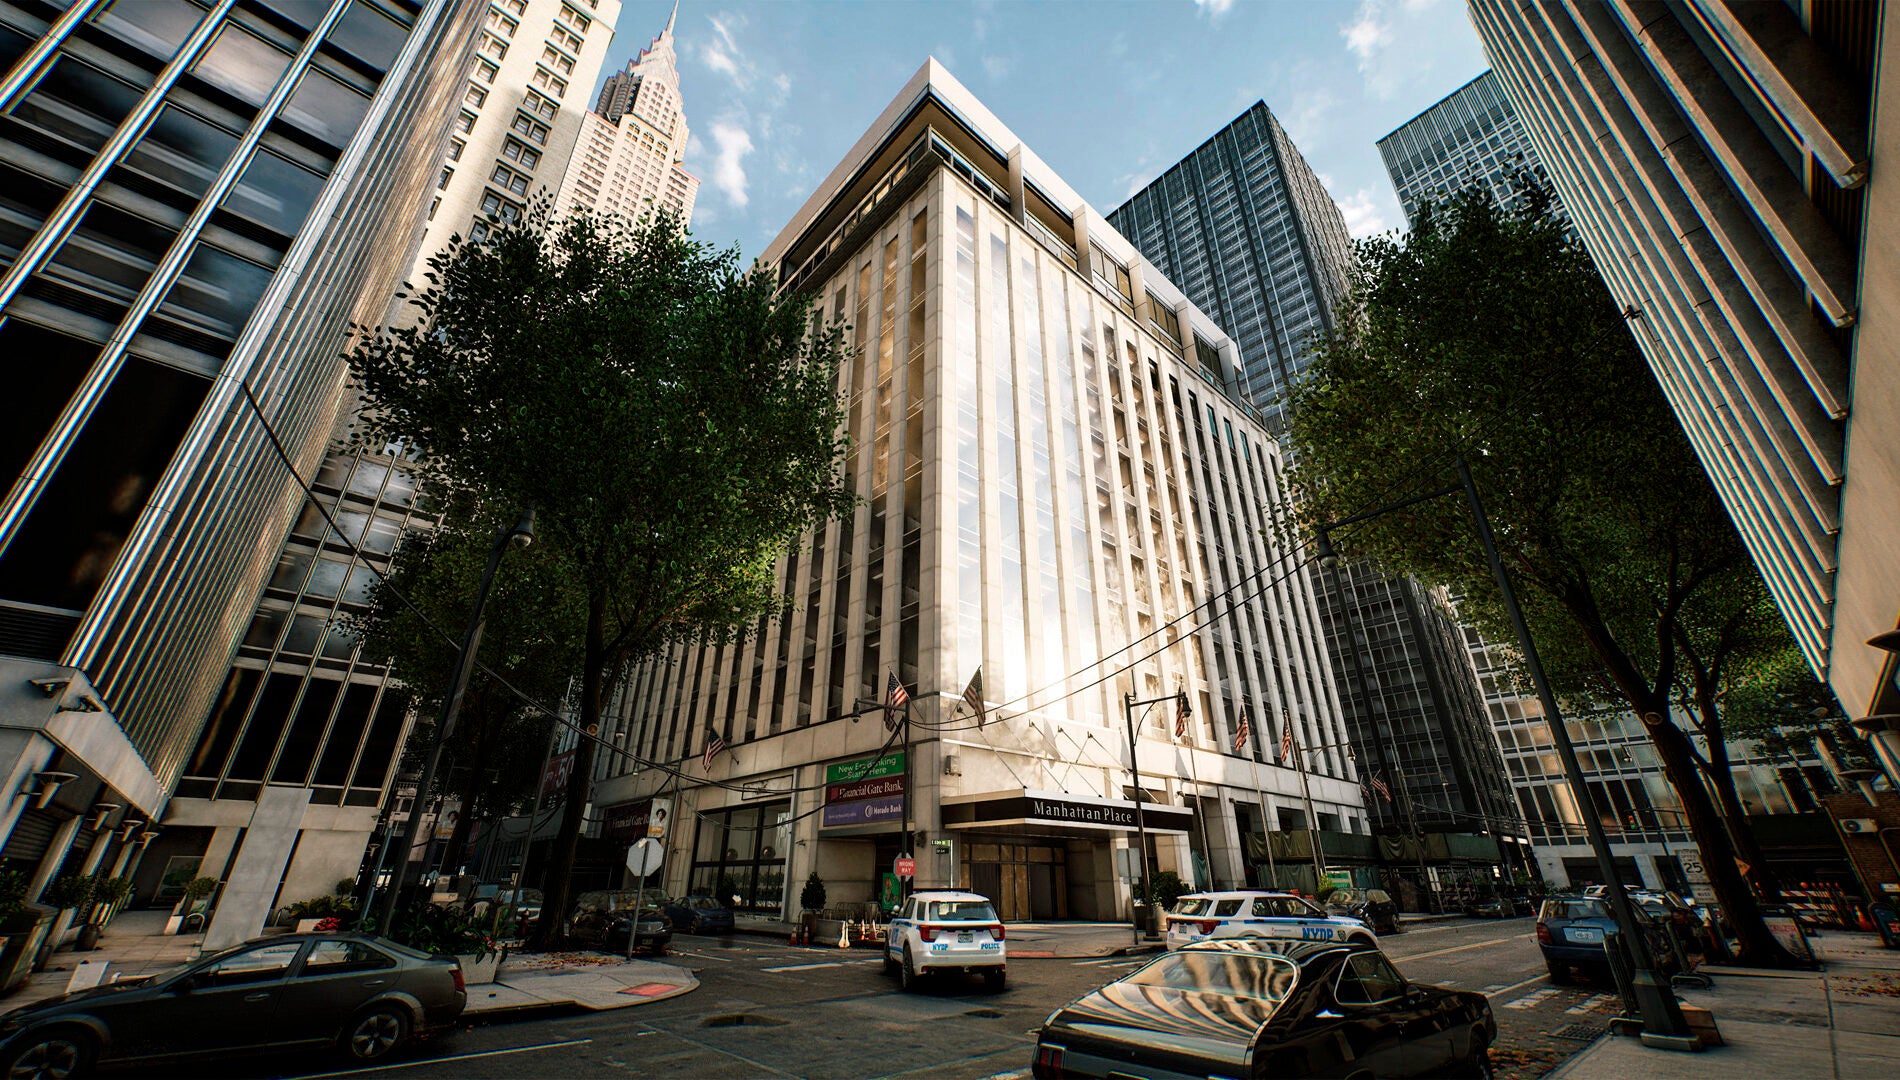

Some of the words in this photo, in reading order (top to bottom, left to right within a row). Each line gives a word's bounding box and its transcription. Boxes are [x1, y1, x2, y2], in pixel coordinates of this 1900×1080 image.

[840, 785, 867, 798] Financial
[867, 784, 884, 795] Gate
[884, 780, 903, 792] Bank
[1034, 801, 1100, 820] Manhattan
[1103, 808, 1132, 822] Place
[1684, 862, 1703, 873] 25
